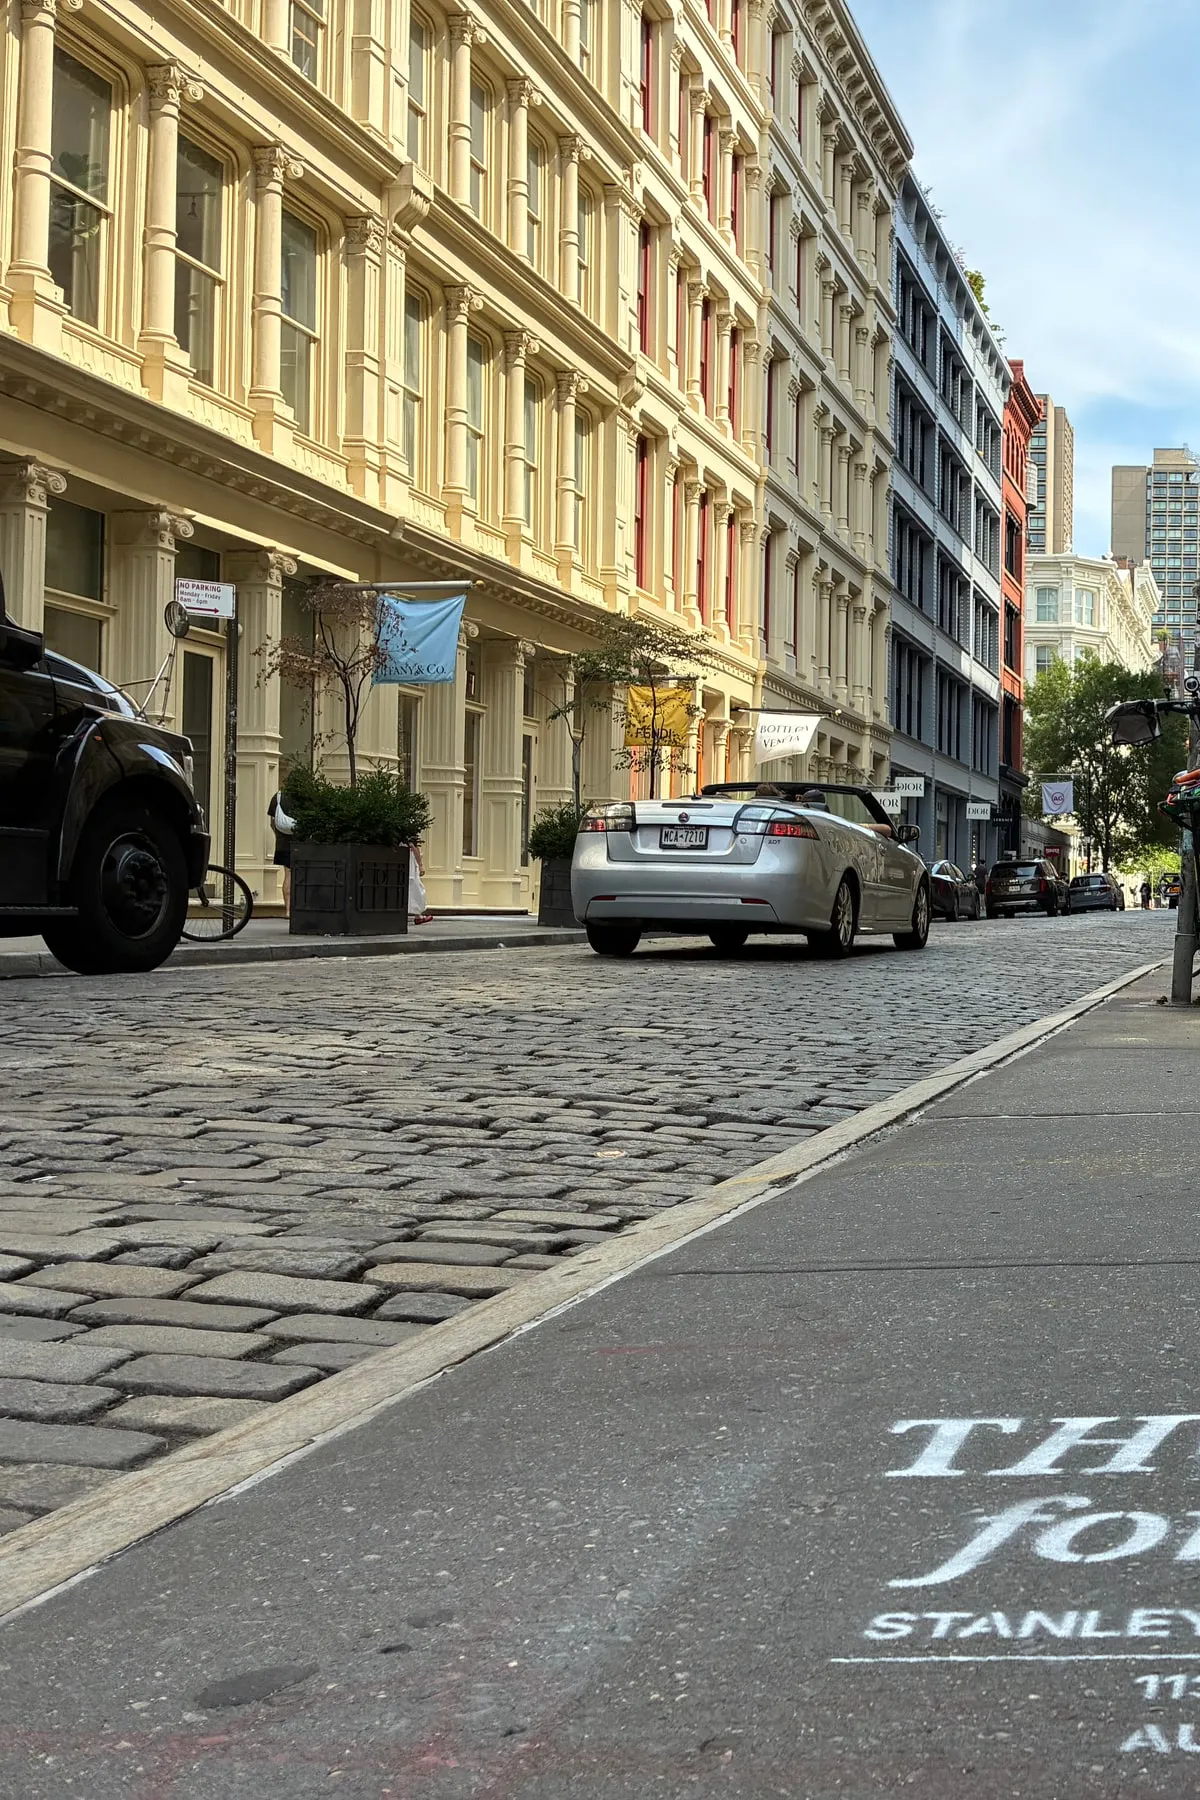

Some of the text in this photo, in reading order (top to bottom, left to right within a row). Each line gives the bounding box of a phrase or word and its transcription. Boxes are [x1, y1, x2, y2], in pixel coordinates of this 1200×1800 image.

[191, 583, 222, 593] PARKING
[180, 590, 201, 598] Monday
[204, 592, 221, 600] Friday
[635, 726, 672, 739] FENDI
[897, 783, 923, 792] DIOR
[880, 800, 899, 808] IOR
[967, 807, 989, 816] DIOR
